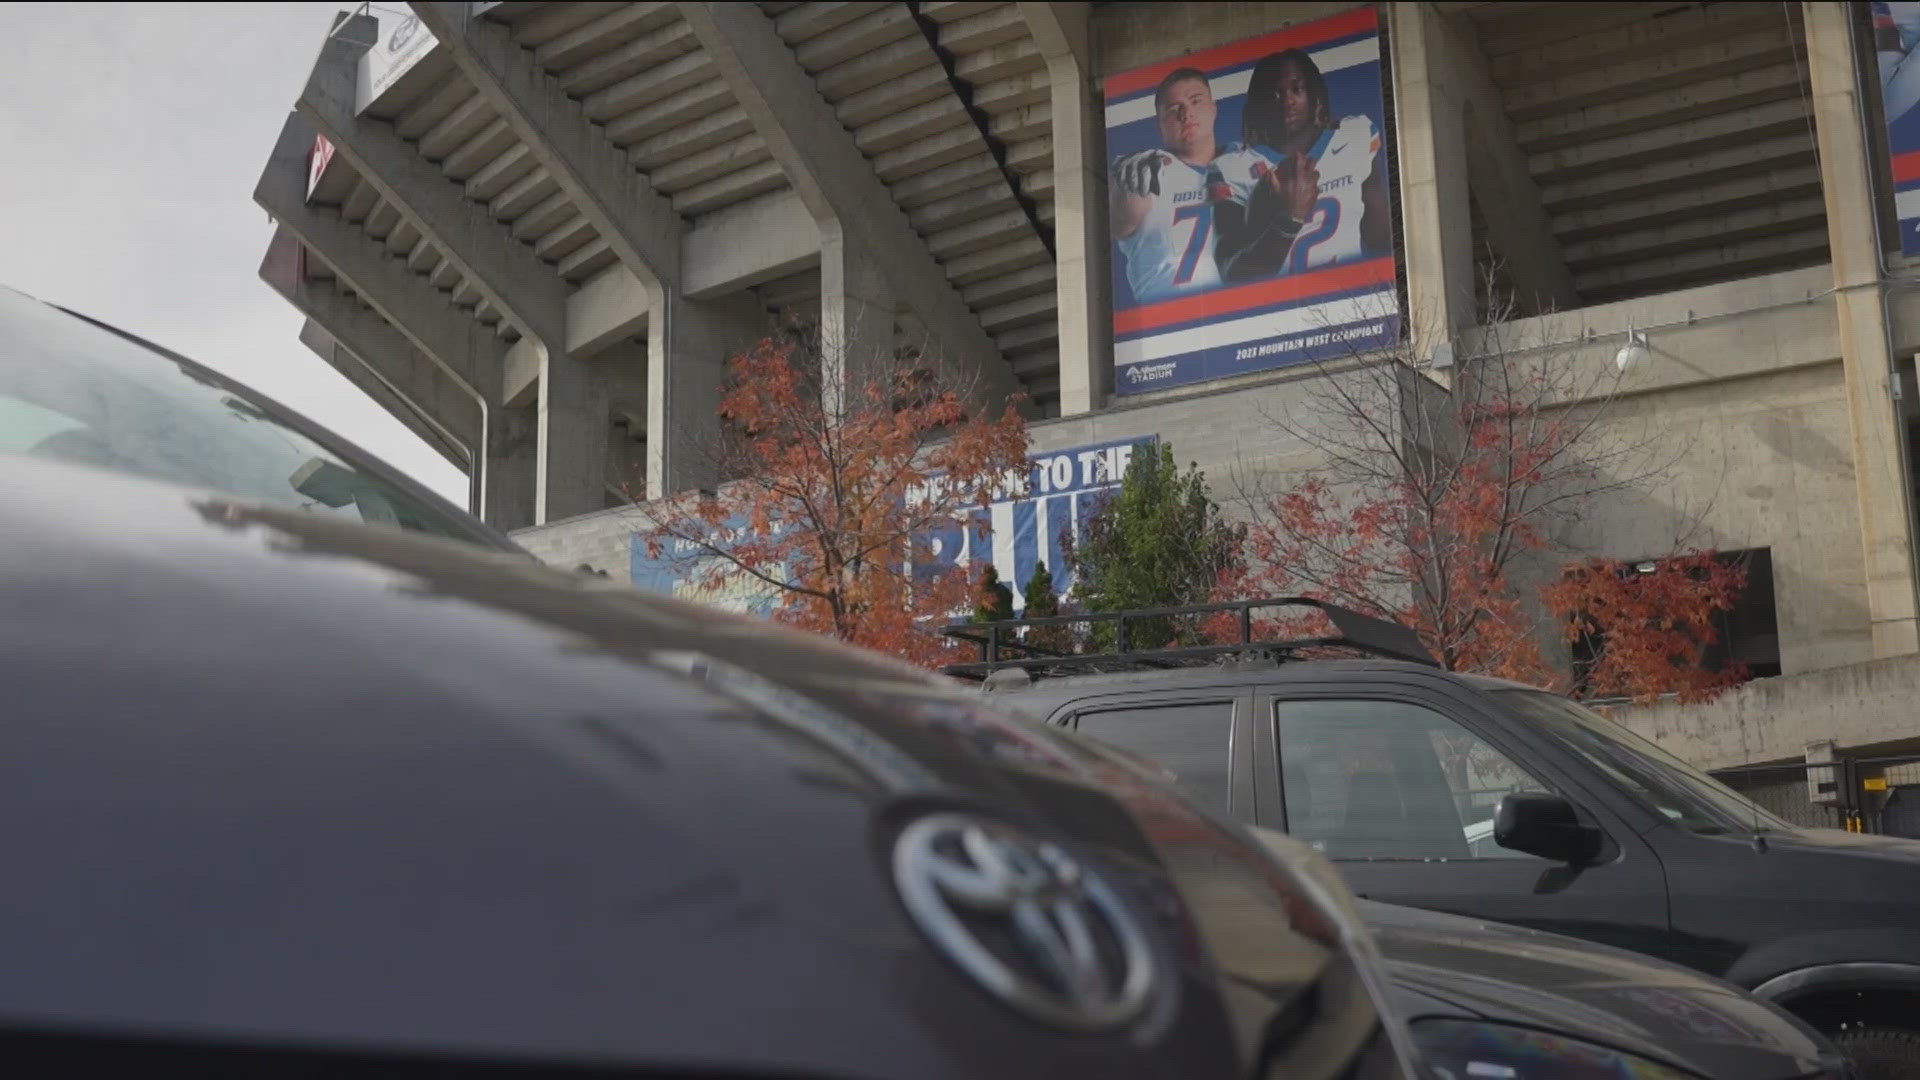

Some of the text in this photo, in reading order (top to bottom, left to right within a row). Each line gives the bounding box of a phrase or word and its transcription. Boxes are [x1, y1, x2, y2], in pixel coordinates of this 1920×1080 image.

[1173, 191, 1203, 204] BOIS
[1172, 202, 1212, 285] 7
[1236, 323, 1385, 361] 2023 MOUNTAIN WEST CHAMPIONS
[1131, 368, 1173, 384] STADIUM
[1038, 455, 1073, 492] TO
